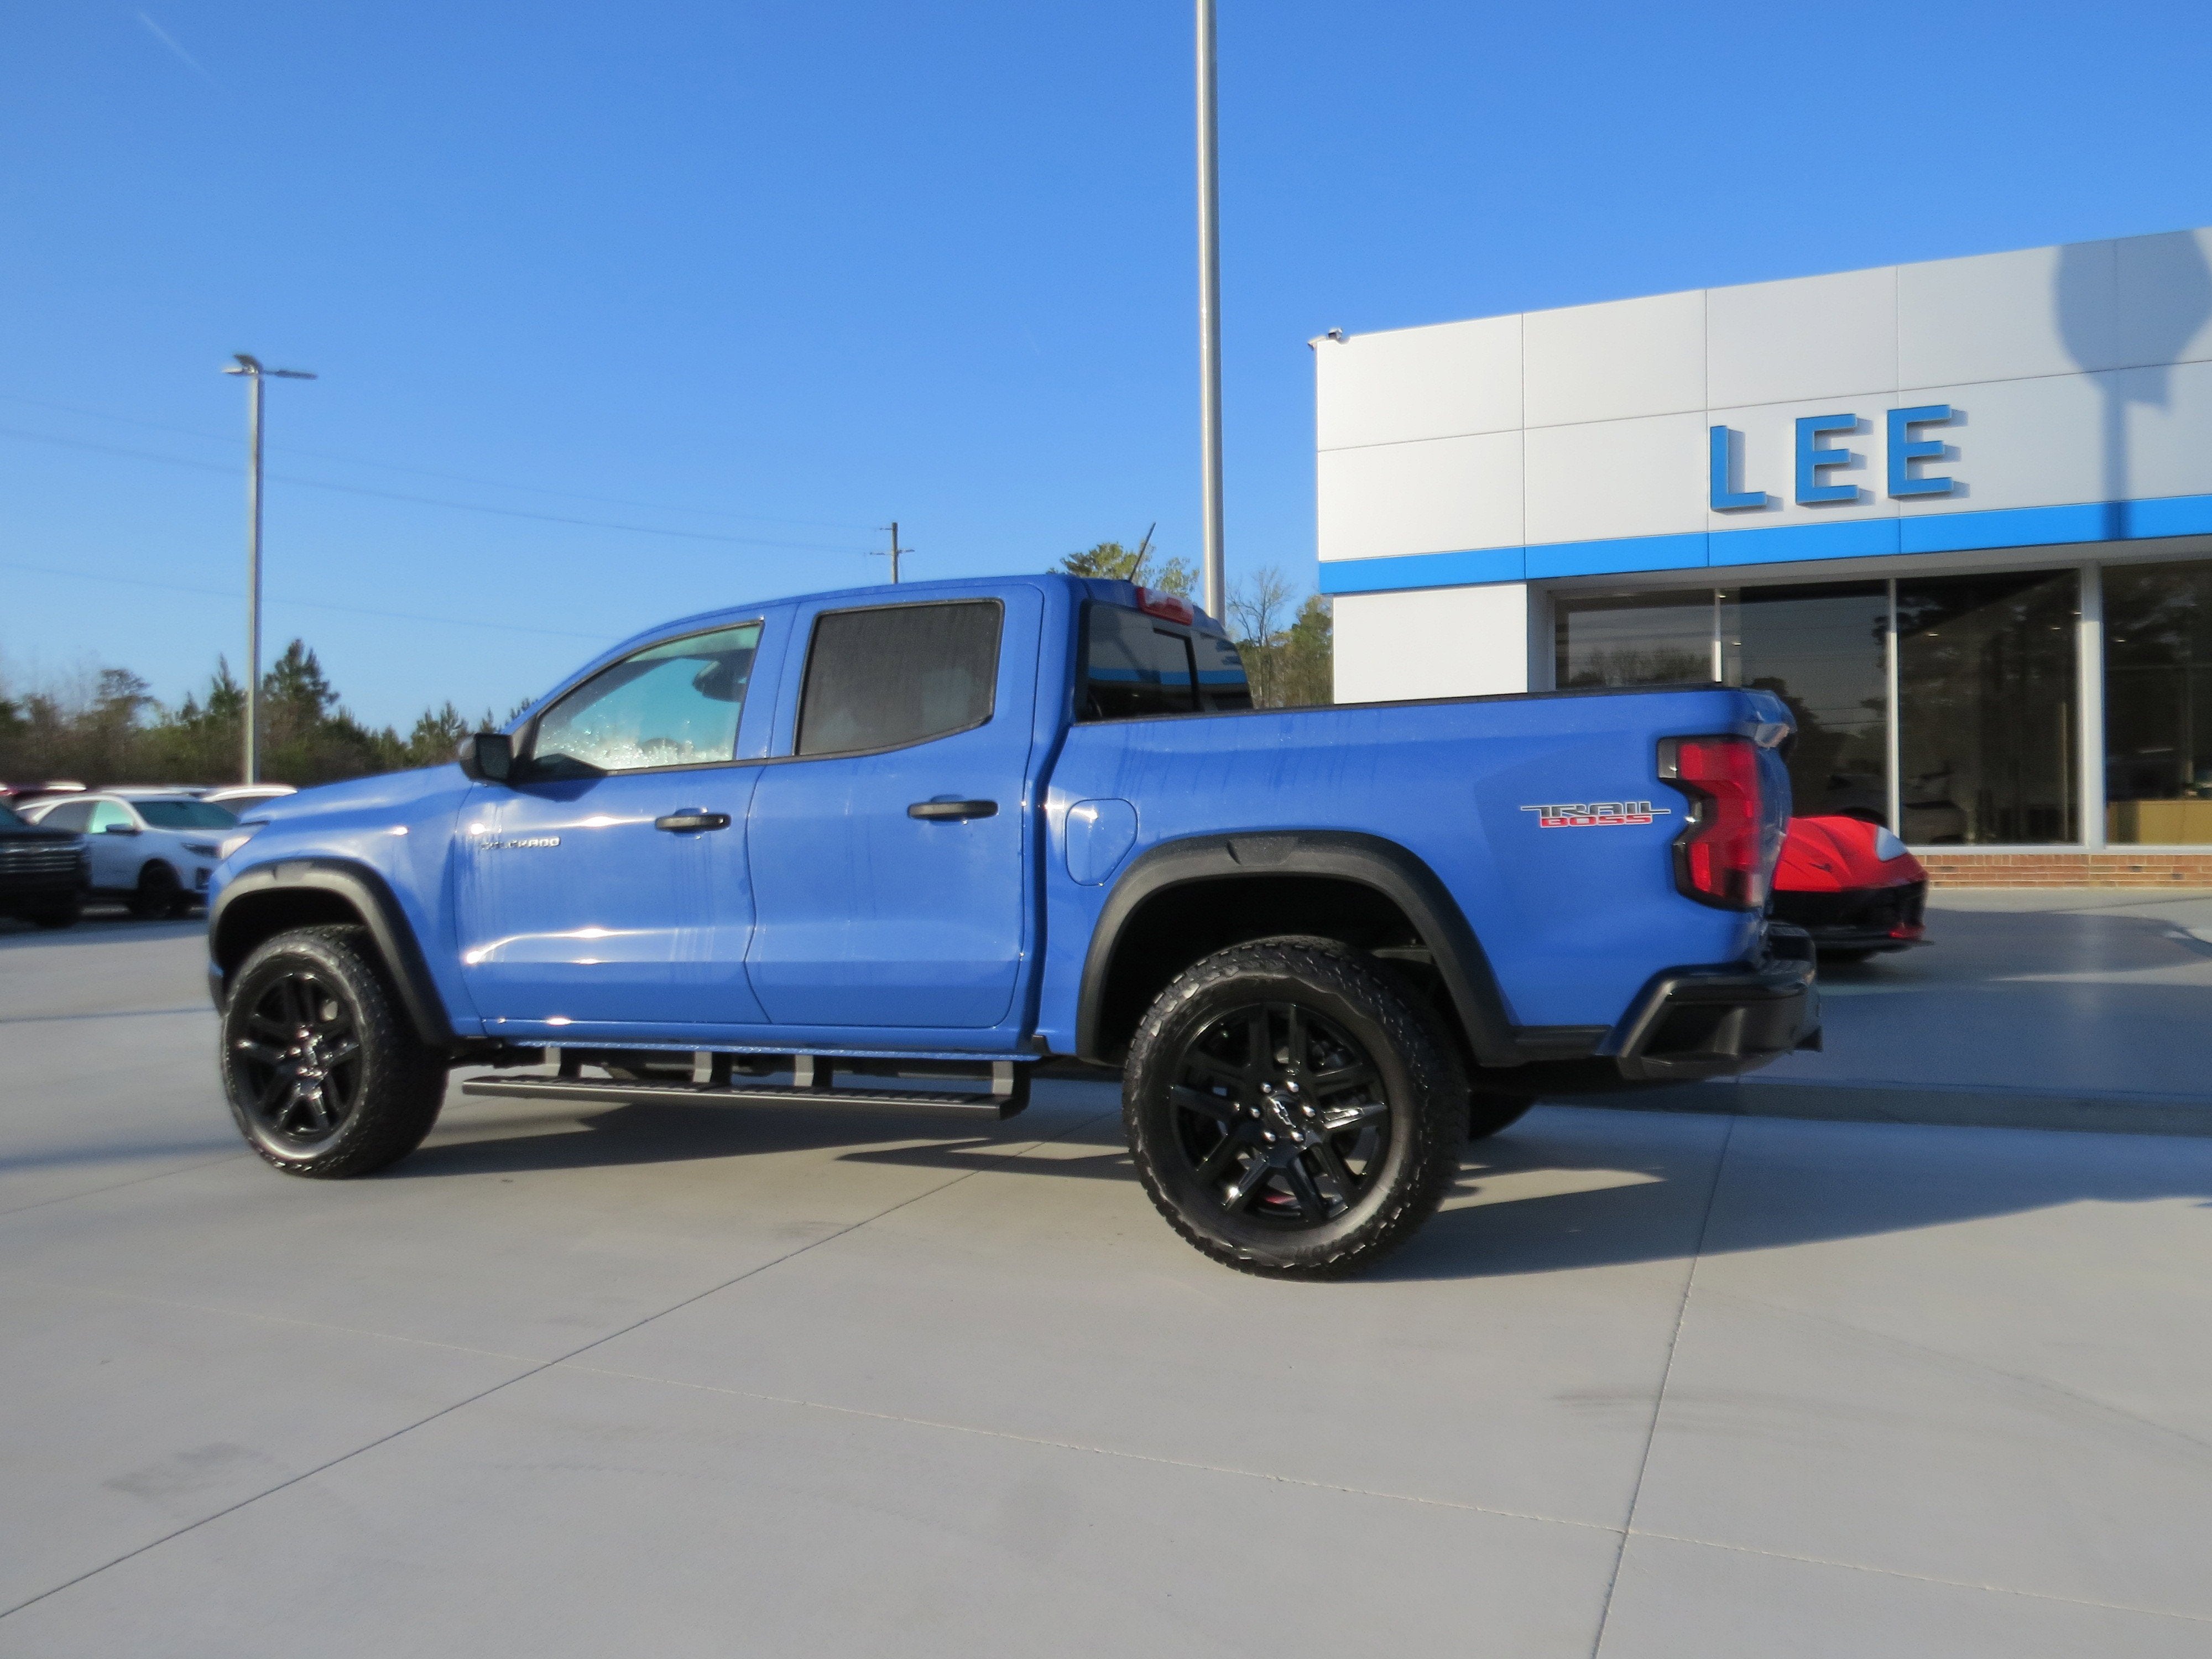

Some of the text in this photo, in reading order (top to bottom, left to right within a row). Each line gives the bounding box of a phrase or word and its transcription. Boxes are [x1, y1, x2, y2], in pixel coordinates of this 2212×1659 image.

[1710, 404, 1954, 512] LEE
[1521, 801, 1671, 817] TRAIL
[1540, 814, 1653, 828] BOSS
[481, 836, 560, 851] ORADO
